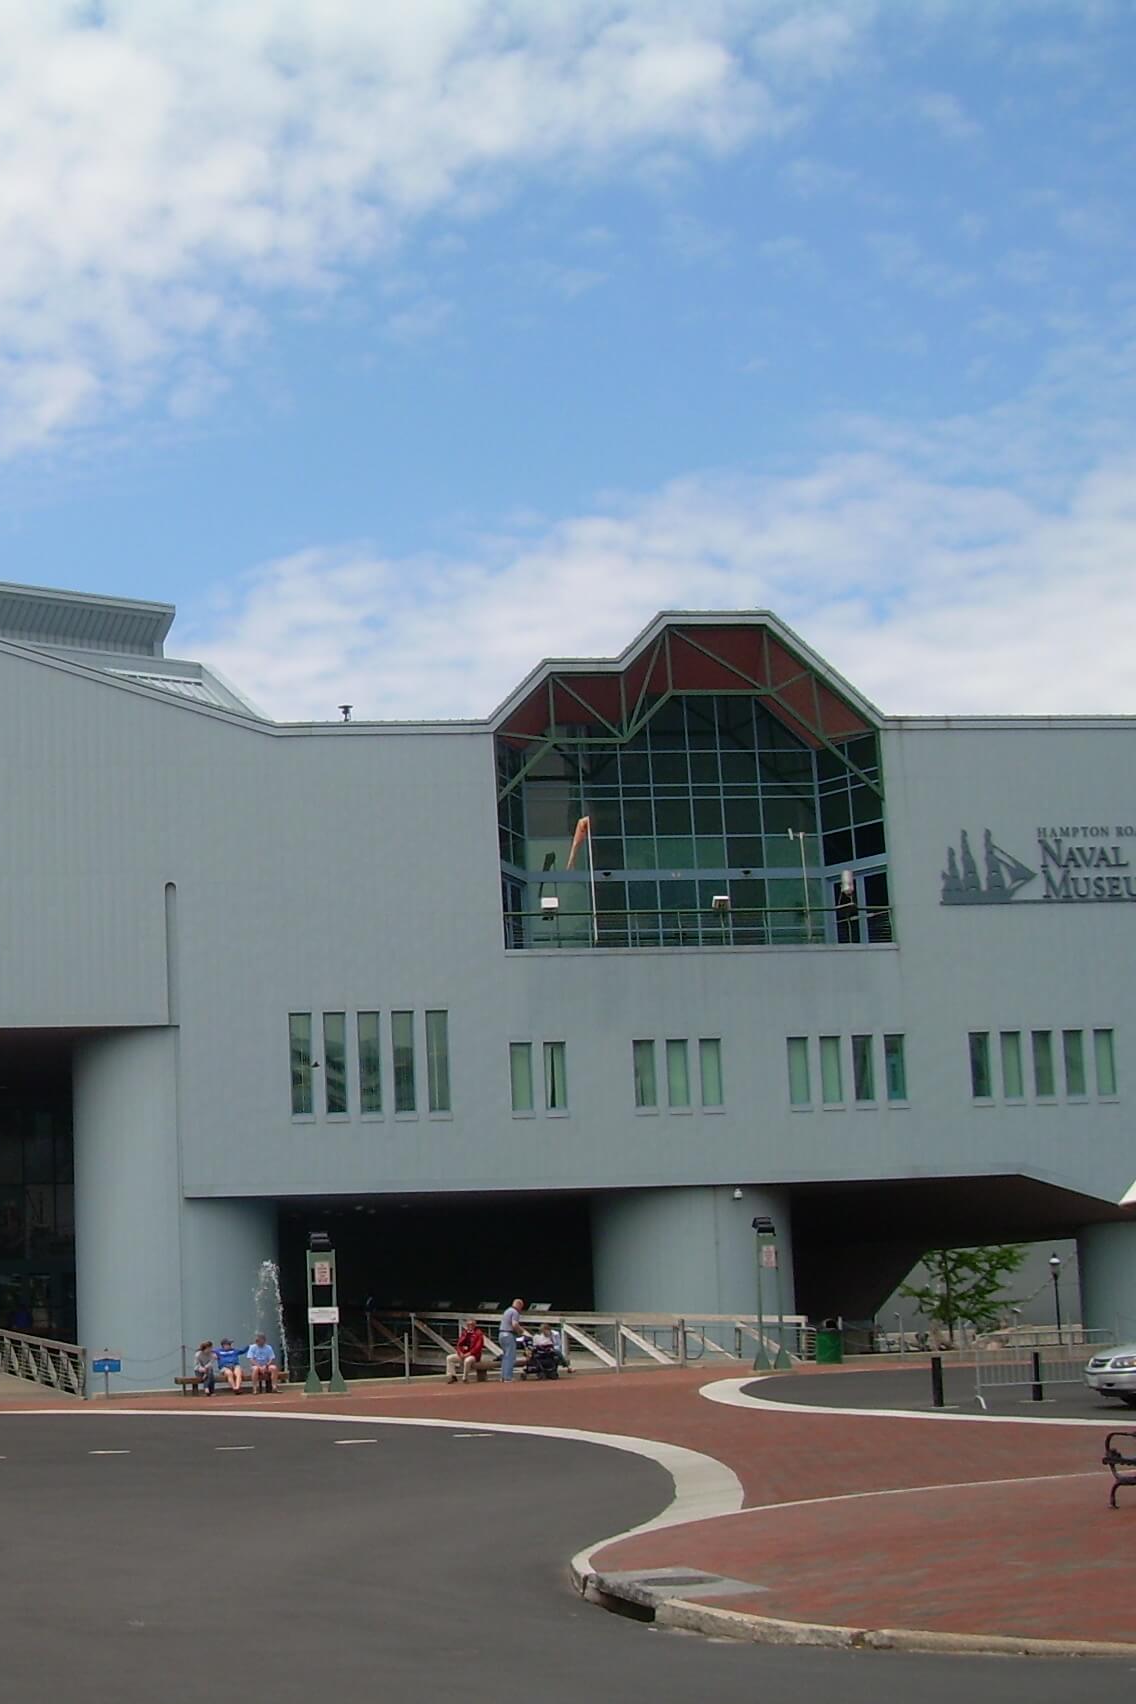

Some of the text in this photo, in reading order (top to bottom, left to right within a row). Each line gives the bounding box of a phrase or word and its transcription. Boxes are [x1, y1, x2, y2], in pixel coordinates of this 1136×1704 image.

[1037, 825, 1136, 838] HAMPTON RO
[1037, 838, 1129, 868] NAVAL
